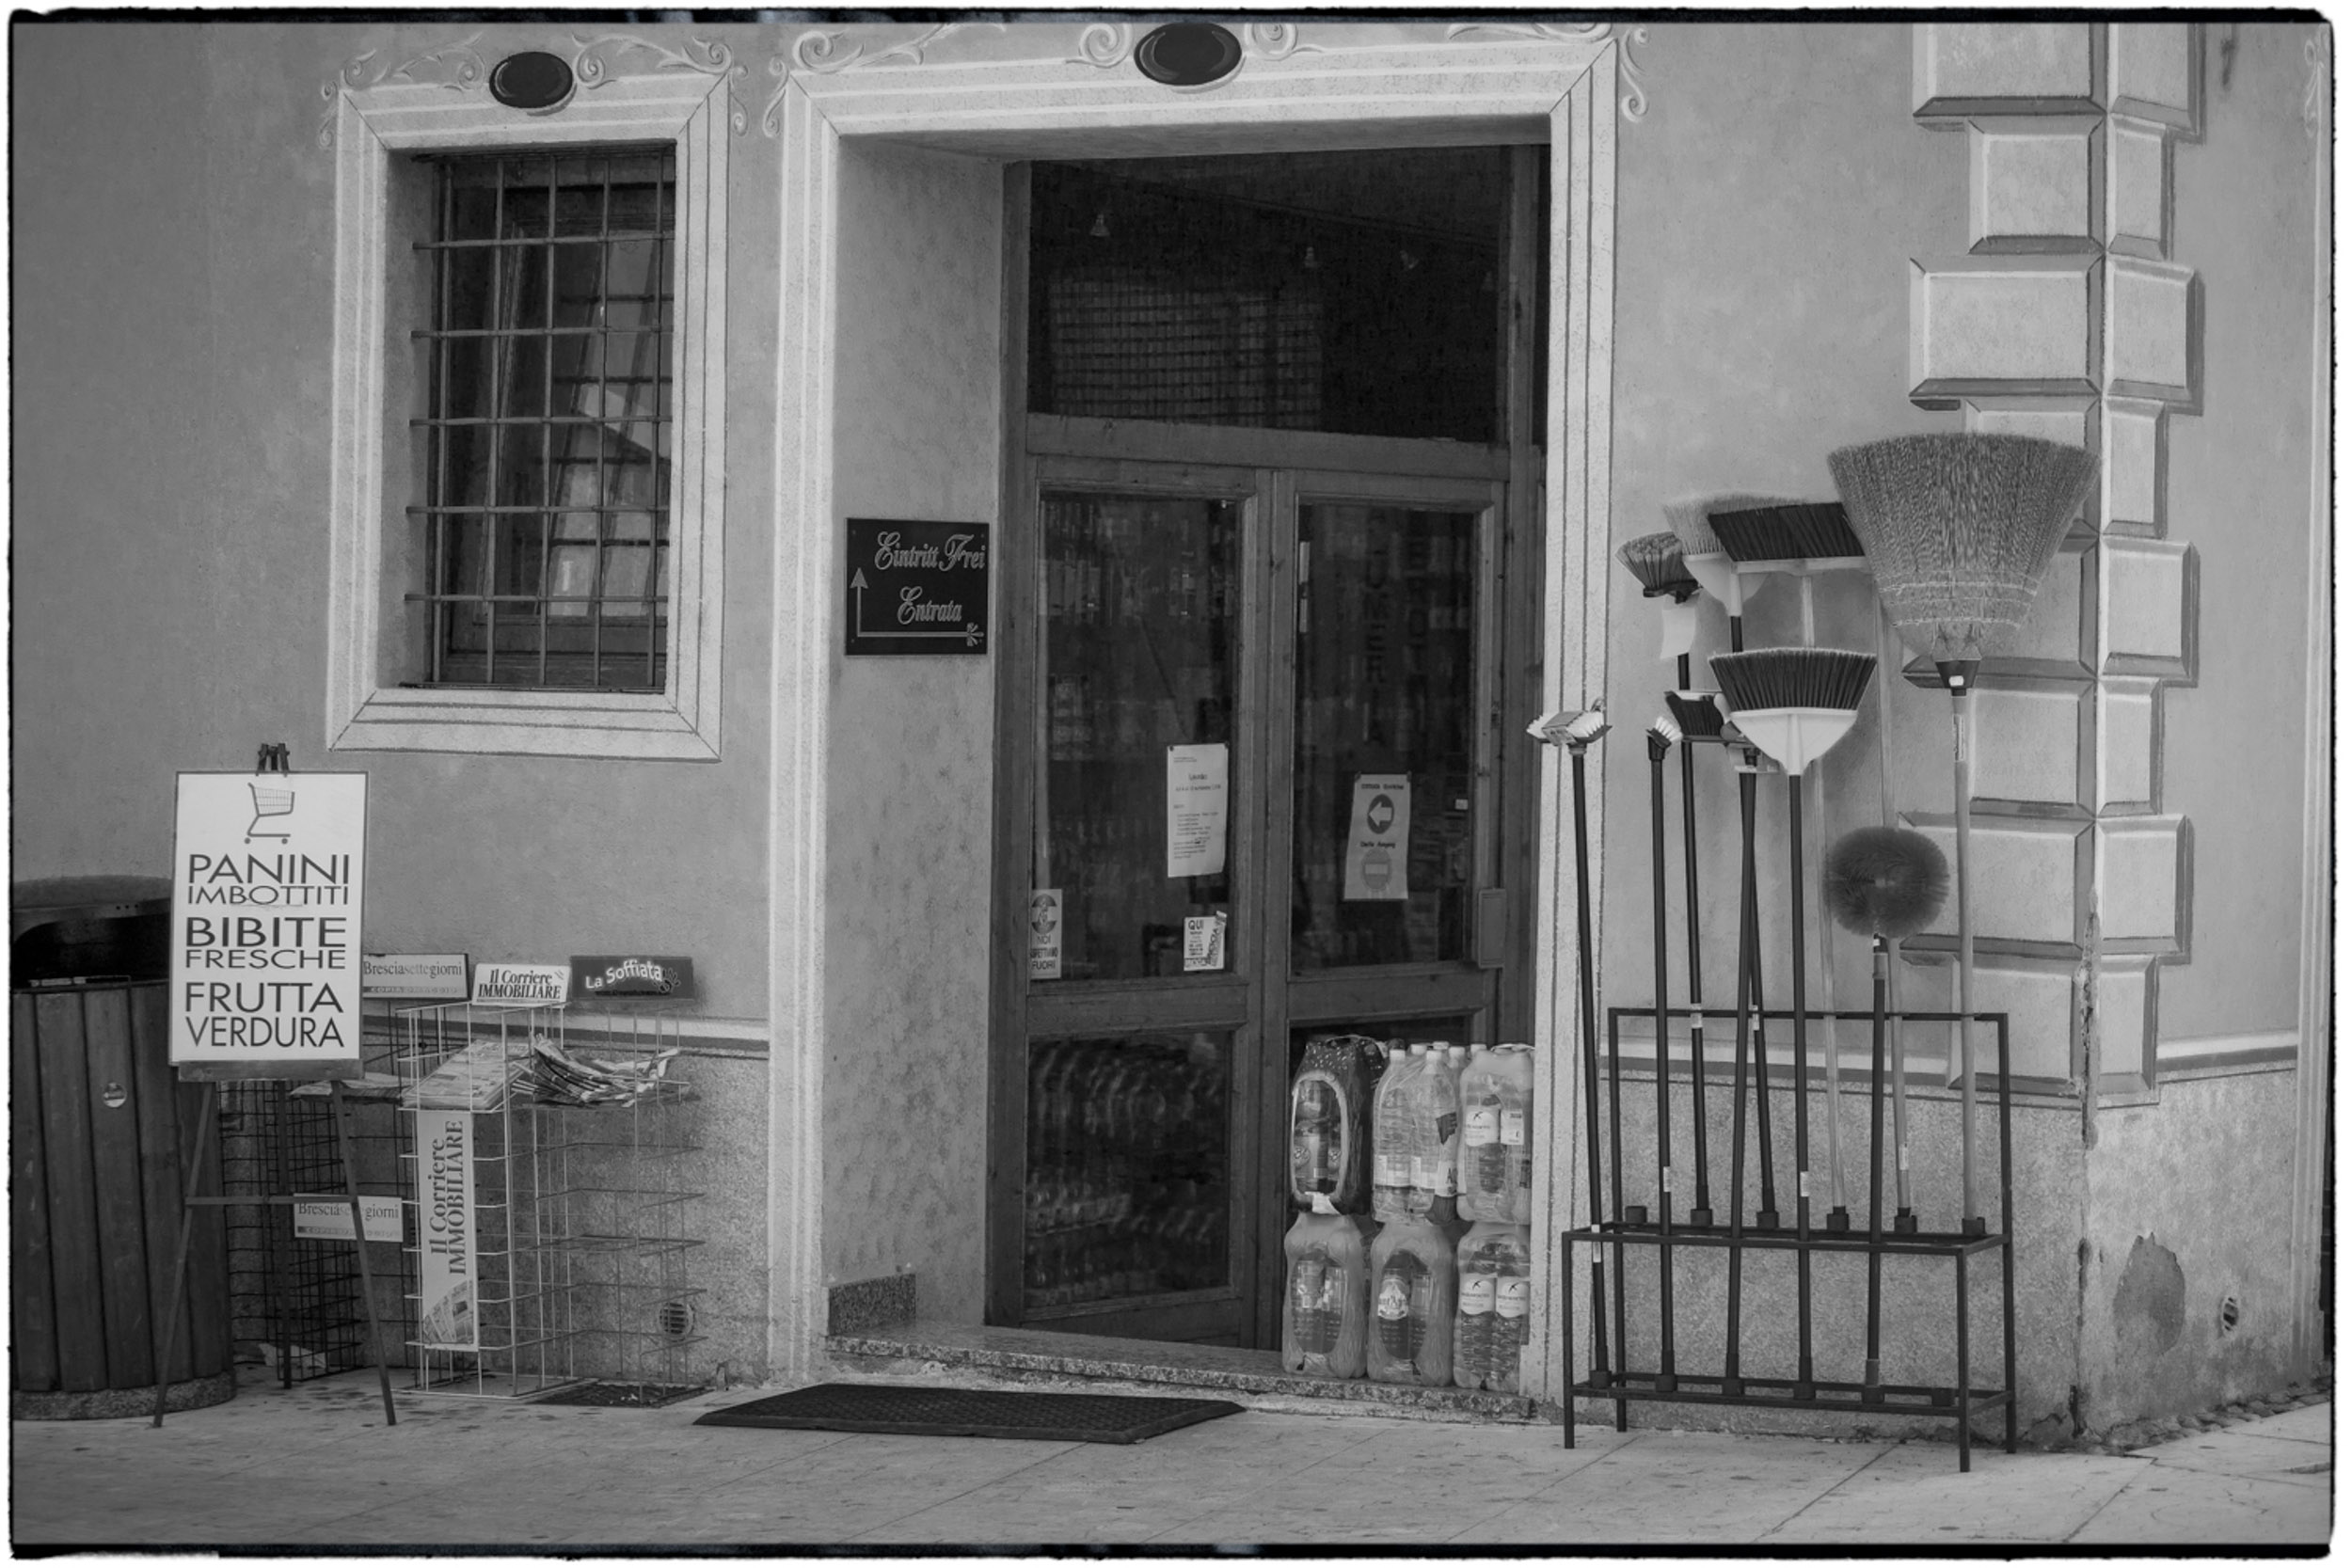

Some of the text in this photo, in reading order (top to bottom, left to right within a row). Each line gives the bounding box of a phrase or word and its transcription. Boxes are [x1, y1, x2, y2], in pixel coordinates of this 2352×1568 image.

[874, 531, 986, 571] Eintritt Frei
[897, 586, 962, 625] Entrata
[189, 853, 350, 884] PANINI
[187, 885, 349, 905] IMBOTTITI
[186, 917, 347, 948] BIBITE
[185, 949, 346, 969] FRESCHE
[585, 959, 663, 989] La Soffiata
[478, 984, 562, 999] IMMOBILIARE
[489, 968, 553, 984] Il Corriere
[185, 982, 344, 1013] FRUTTA
[185, 1017, 344, 1048] VERDURA
[427, 1138, 448, 1255] Il Corriere
[445, 1120, 468, 1275] IMMOBILIARE
